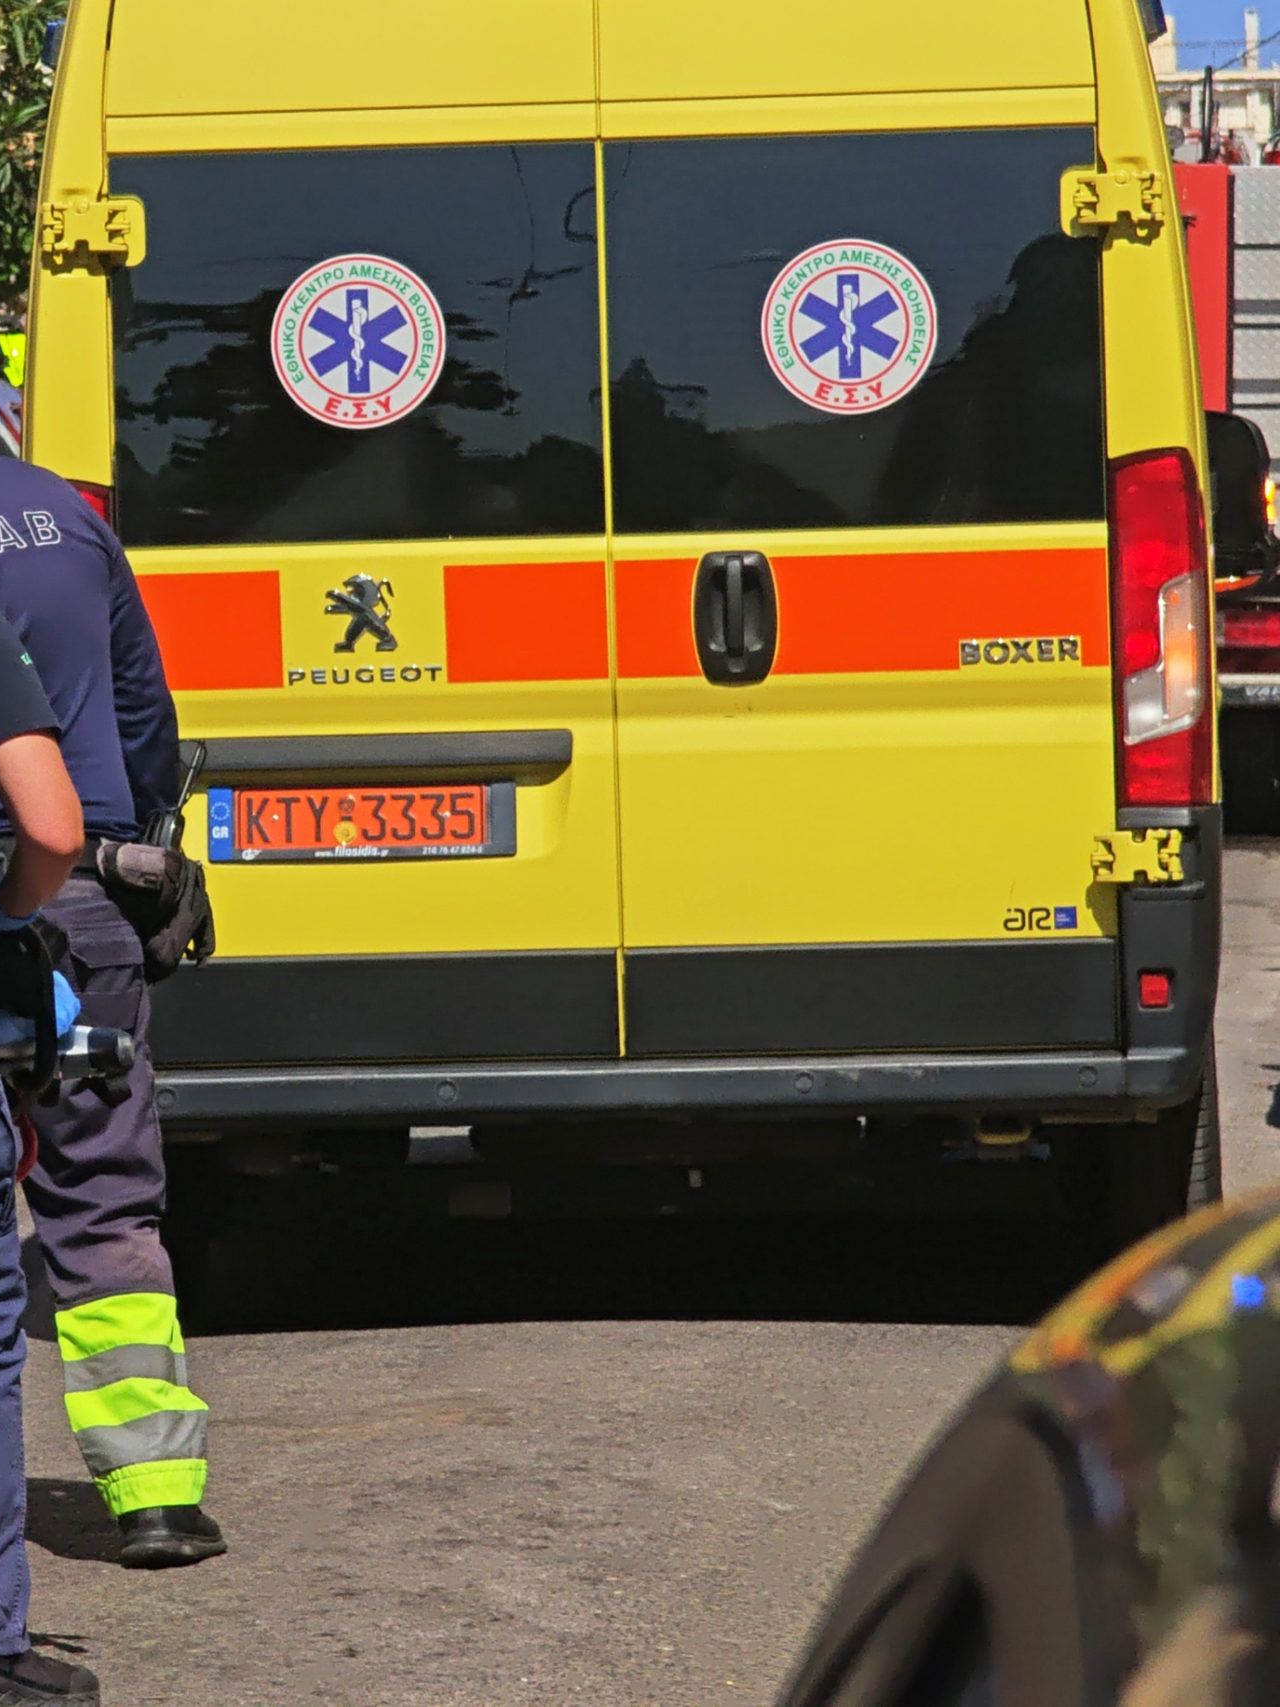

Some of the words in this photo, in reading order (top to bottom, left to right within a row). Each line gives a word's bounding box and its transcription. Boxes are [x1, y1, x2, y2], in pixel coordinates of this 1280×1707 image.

[349, 265, 411, 295] ΑΜΕΣΗΣ
[781, 252, 835, 299] ΚΕΝΤΡΟ
[839, 250, 902, 281] ΑΜΕΣΗΣ
[290, 267, 344, 314] ΚΕΝΤΡΟ
[408, 293, 434, 381] ΒΟΗΘΕΙΑΣ
[773, 303, 795, 369] ΕΘΝΙΚΟ
[900, 278, 926, 366] ΒΟΗΘΕΙΑΣ
[283, 318, 305, 384] ΕΘΝΙΚΟ
[288, 664, 442, 686] PEUGEOT
[961, 637, 1080, 666] BOXER
[212, 826, 229, 839] GR
[361, 793, 475, 841] 3335
